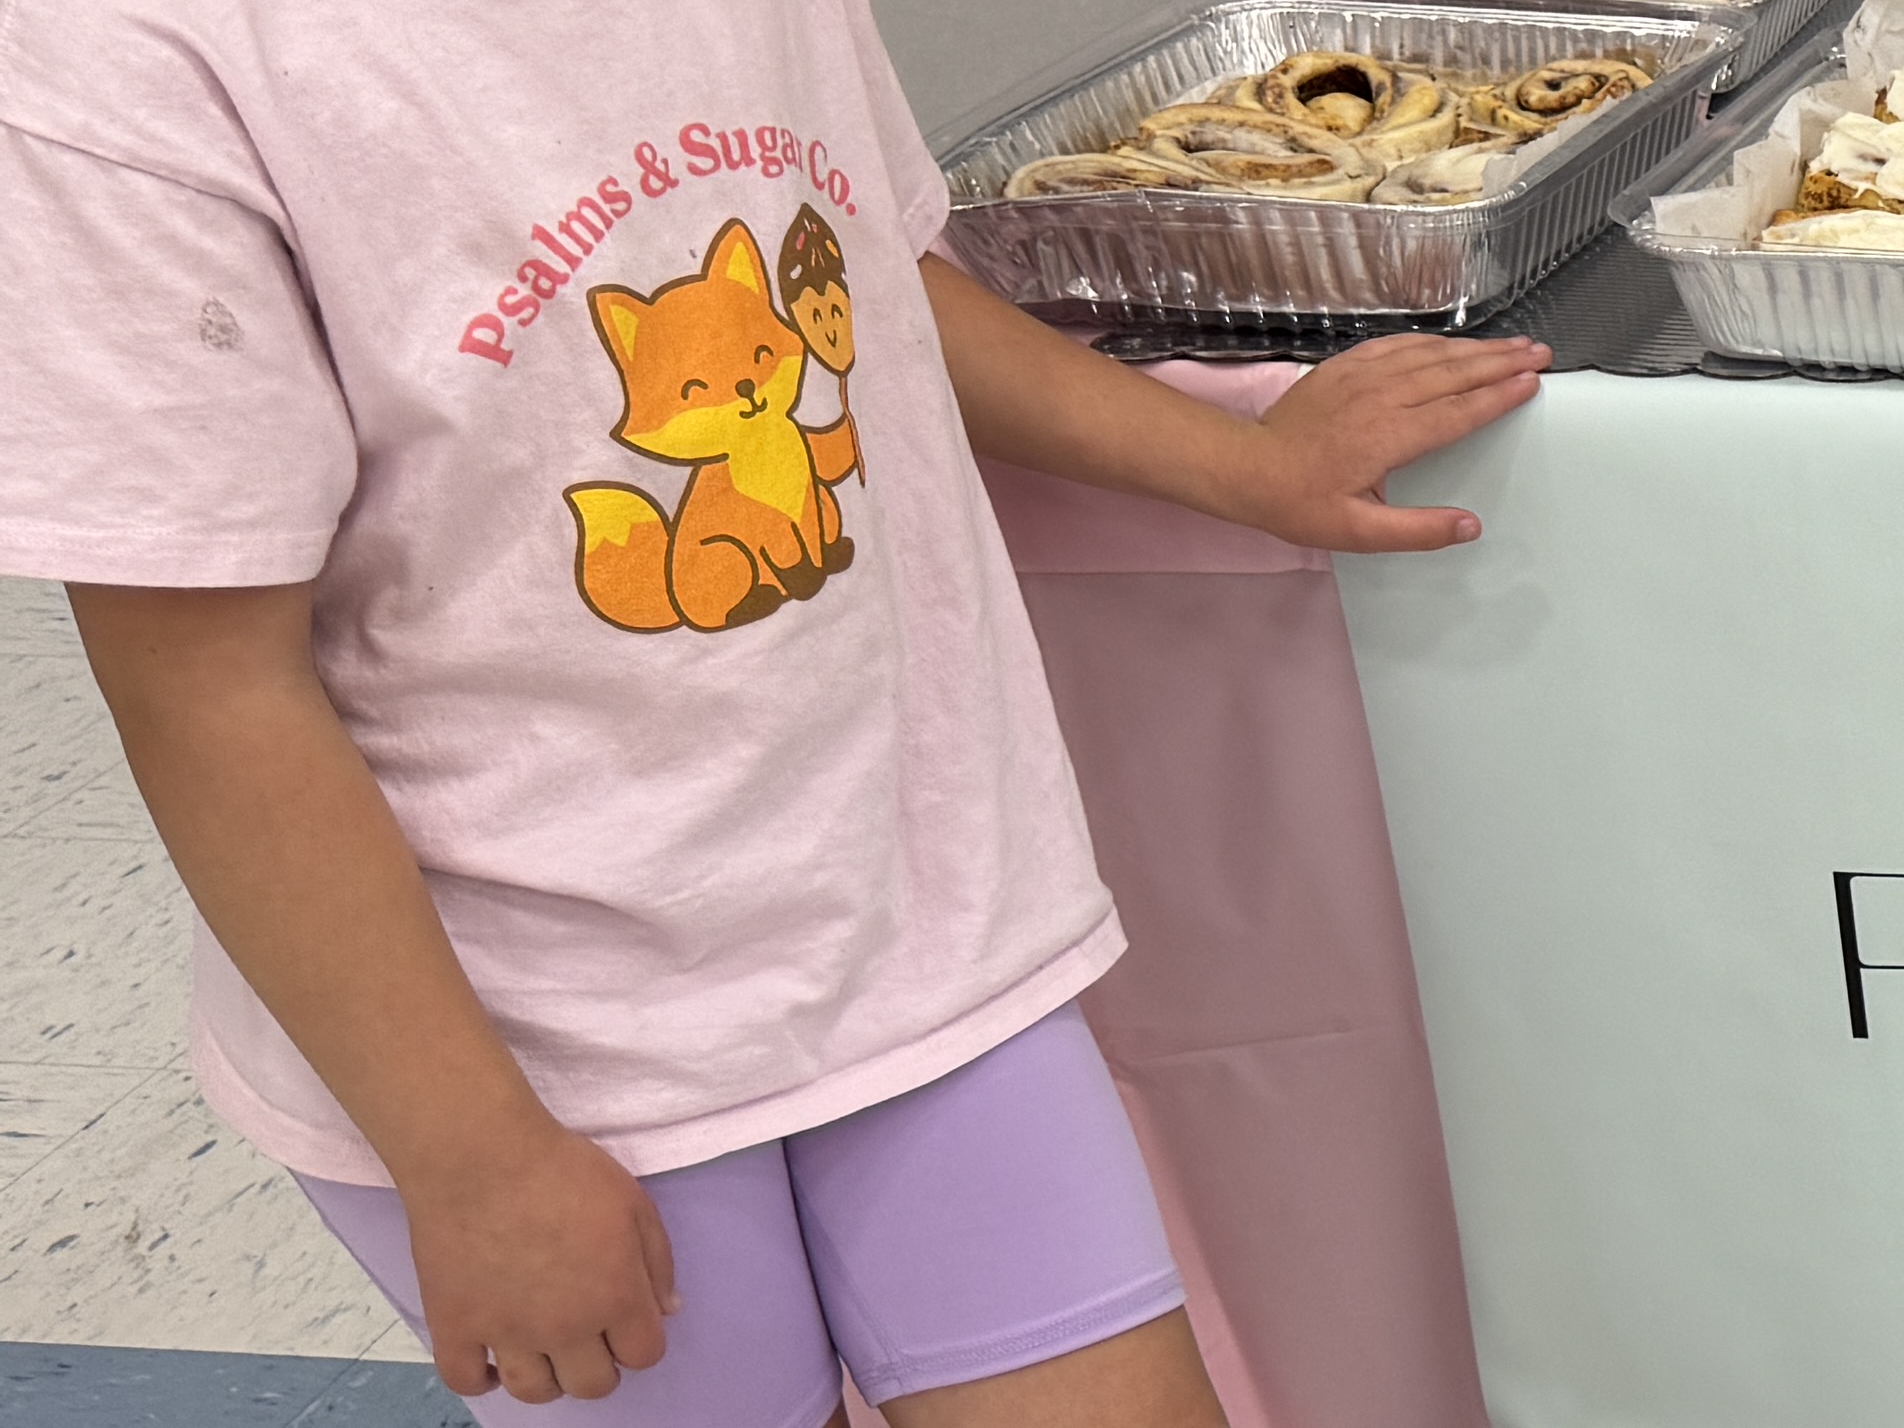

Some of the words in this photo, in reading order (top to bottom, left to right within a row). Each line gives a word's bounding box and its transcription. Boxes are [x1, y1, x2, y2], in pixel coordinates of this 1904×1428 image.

[457, 175, 635, 369] Psalms
[633, 140, 680, 200] &
[678, 122, 804, 180] Sugar
[808, 139, 858, 218] Co.
